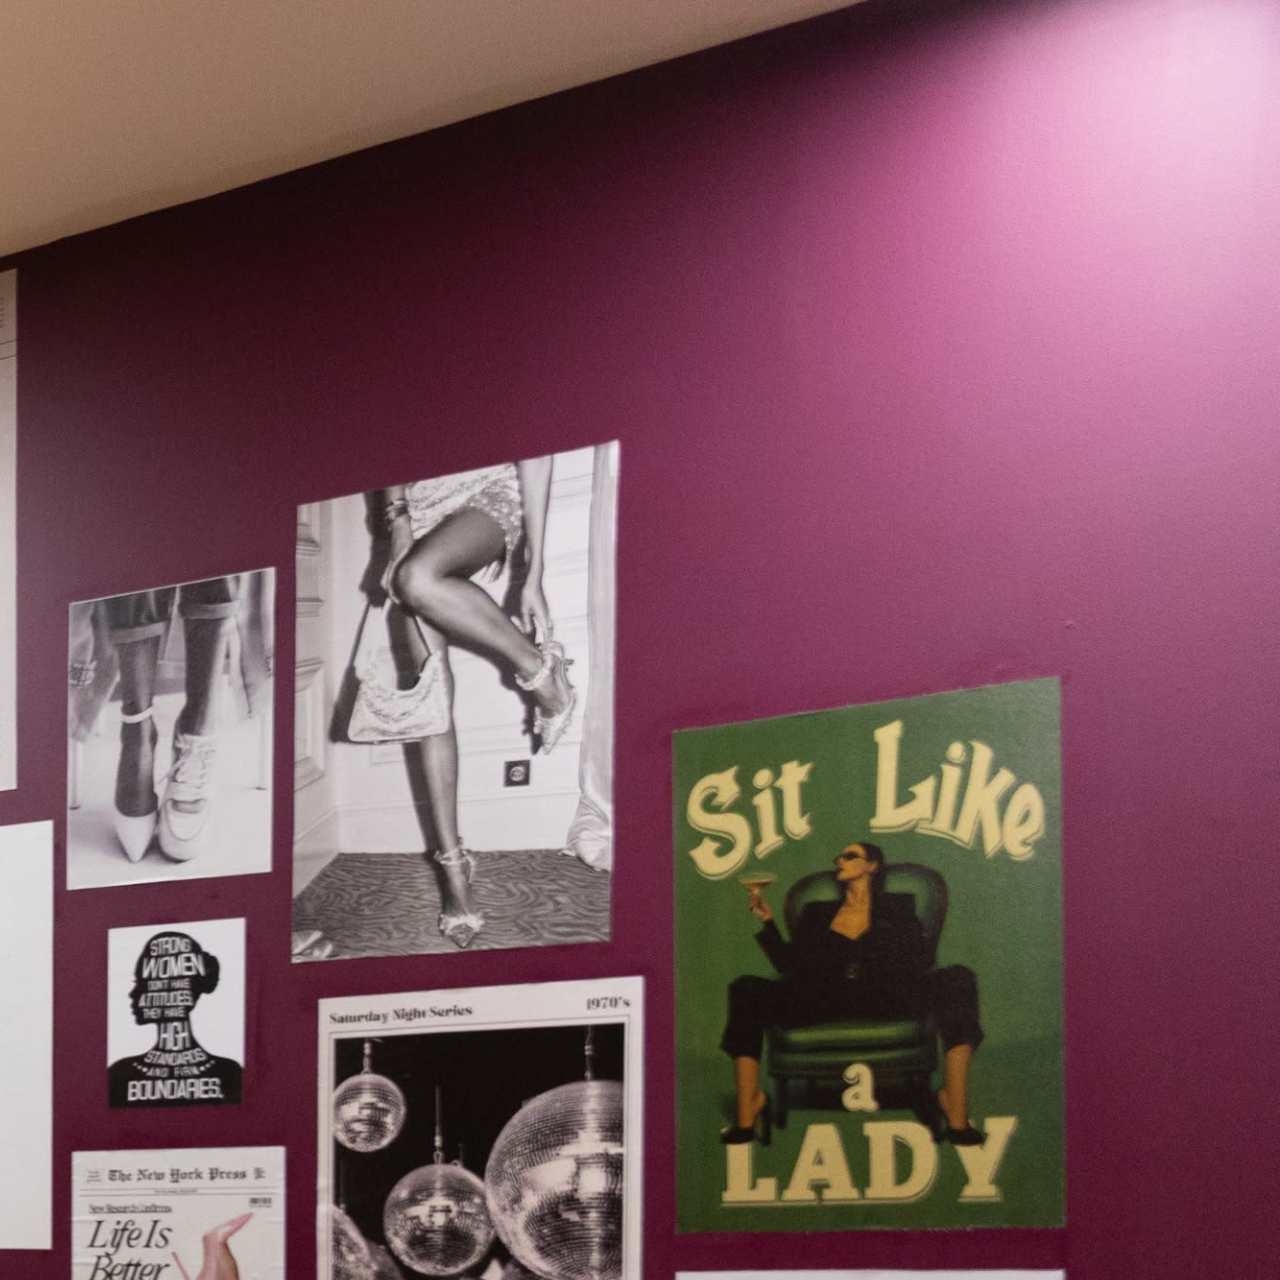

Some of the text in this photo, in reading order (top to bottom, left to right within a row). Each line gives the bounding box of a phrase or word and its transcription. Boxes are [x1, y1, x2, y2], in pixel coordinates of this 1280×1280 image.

[686, 719, 1046, 881] Sit Like
[150, 936, 191, 957] STRONG
[142, 953, 206, 979] WOMEN
[329, 1004, 473, 1026] Saturday Night Series
[586, 996, 631, 1011] 1970's
[159, 1021, 190, 1051] HIGH
[127, 1078, 224, 1101] BOUNDARIES.
[841, 1061, 879, 1113] a
[720, 1115, 1019, 1207] LADY
[108, 1169, 132, 1182] The
[136, 1168, 165, 1182] New
[169, 1167, 204, 1184] York
[208, 1167, 247, 1182] Press
[88, 1219, 173, 1256] Life Is
